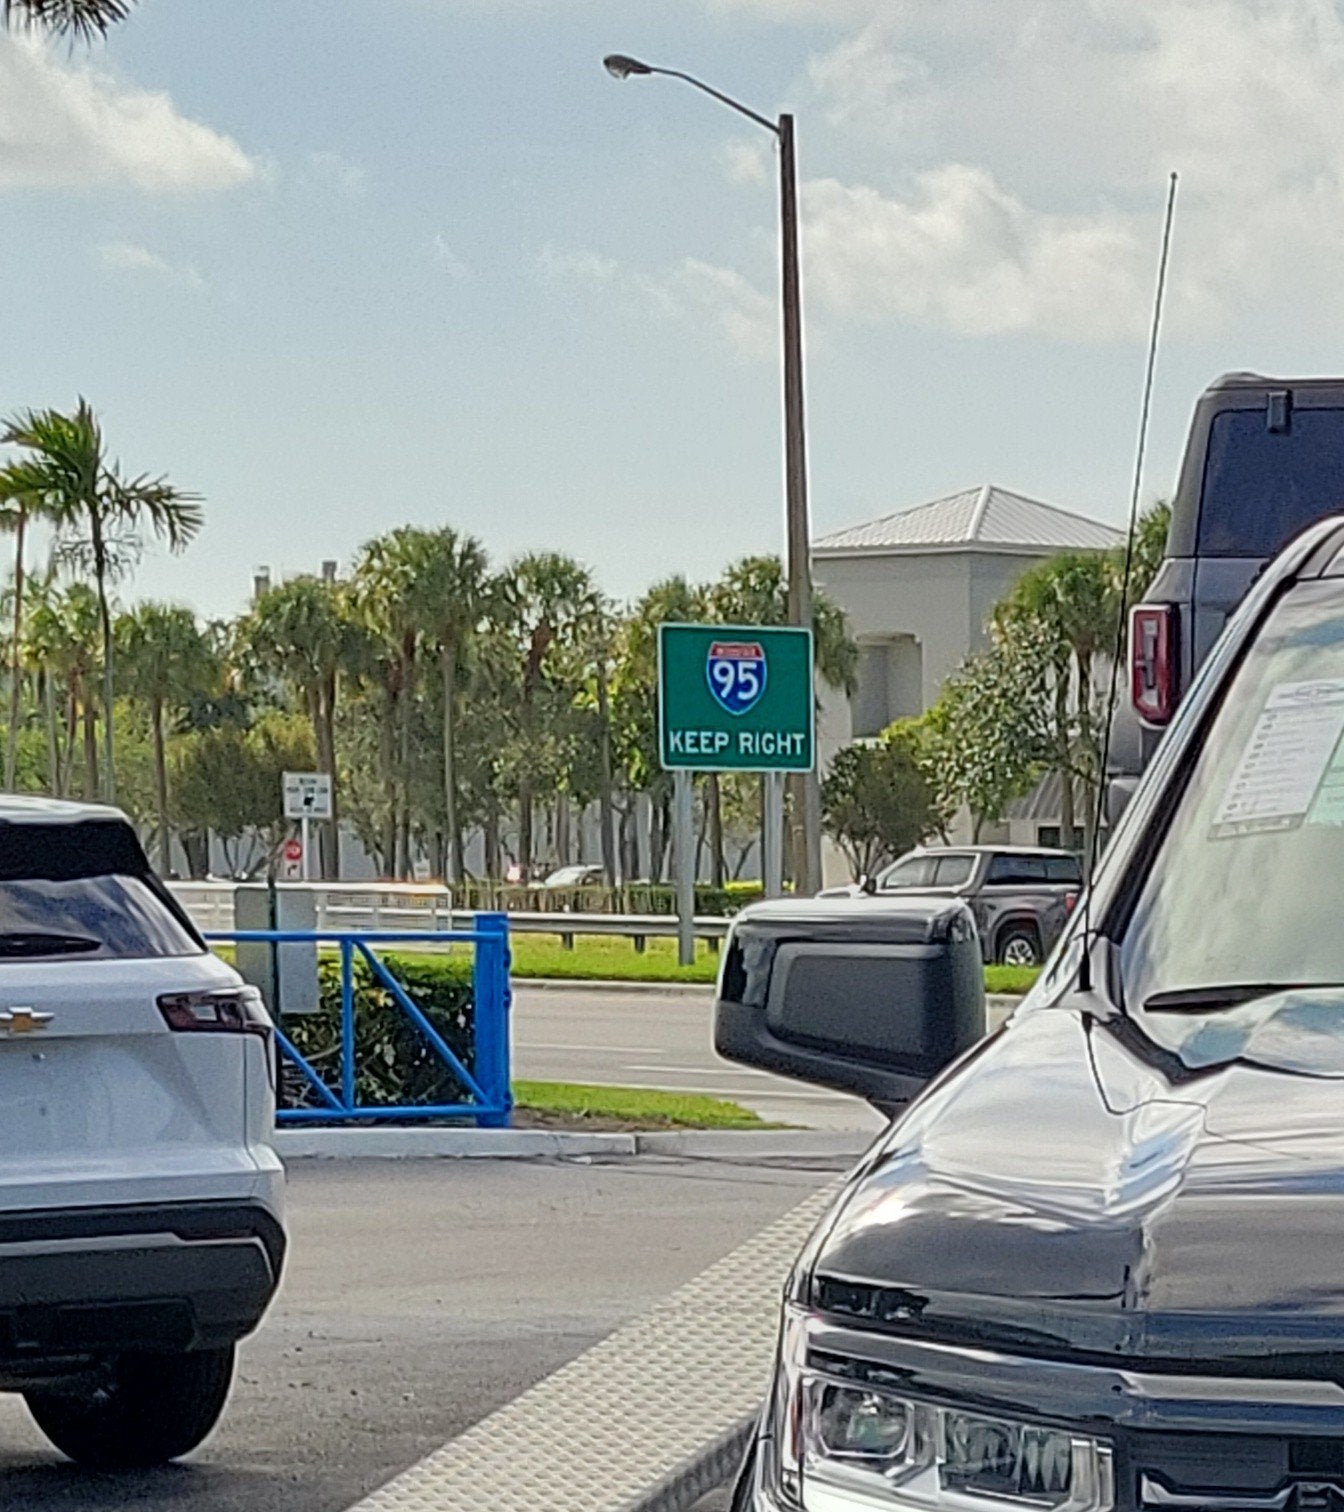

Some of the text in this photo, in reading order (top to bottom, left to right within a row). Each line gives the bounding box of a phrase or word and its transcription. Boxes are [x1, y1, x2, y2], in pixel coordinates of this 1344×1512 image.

[712, 660, 759, 701] 95
[669, 730, 805, 755] KEEP RIGHT
